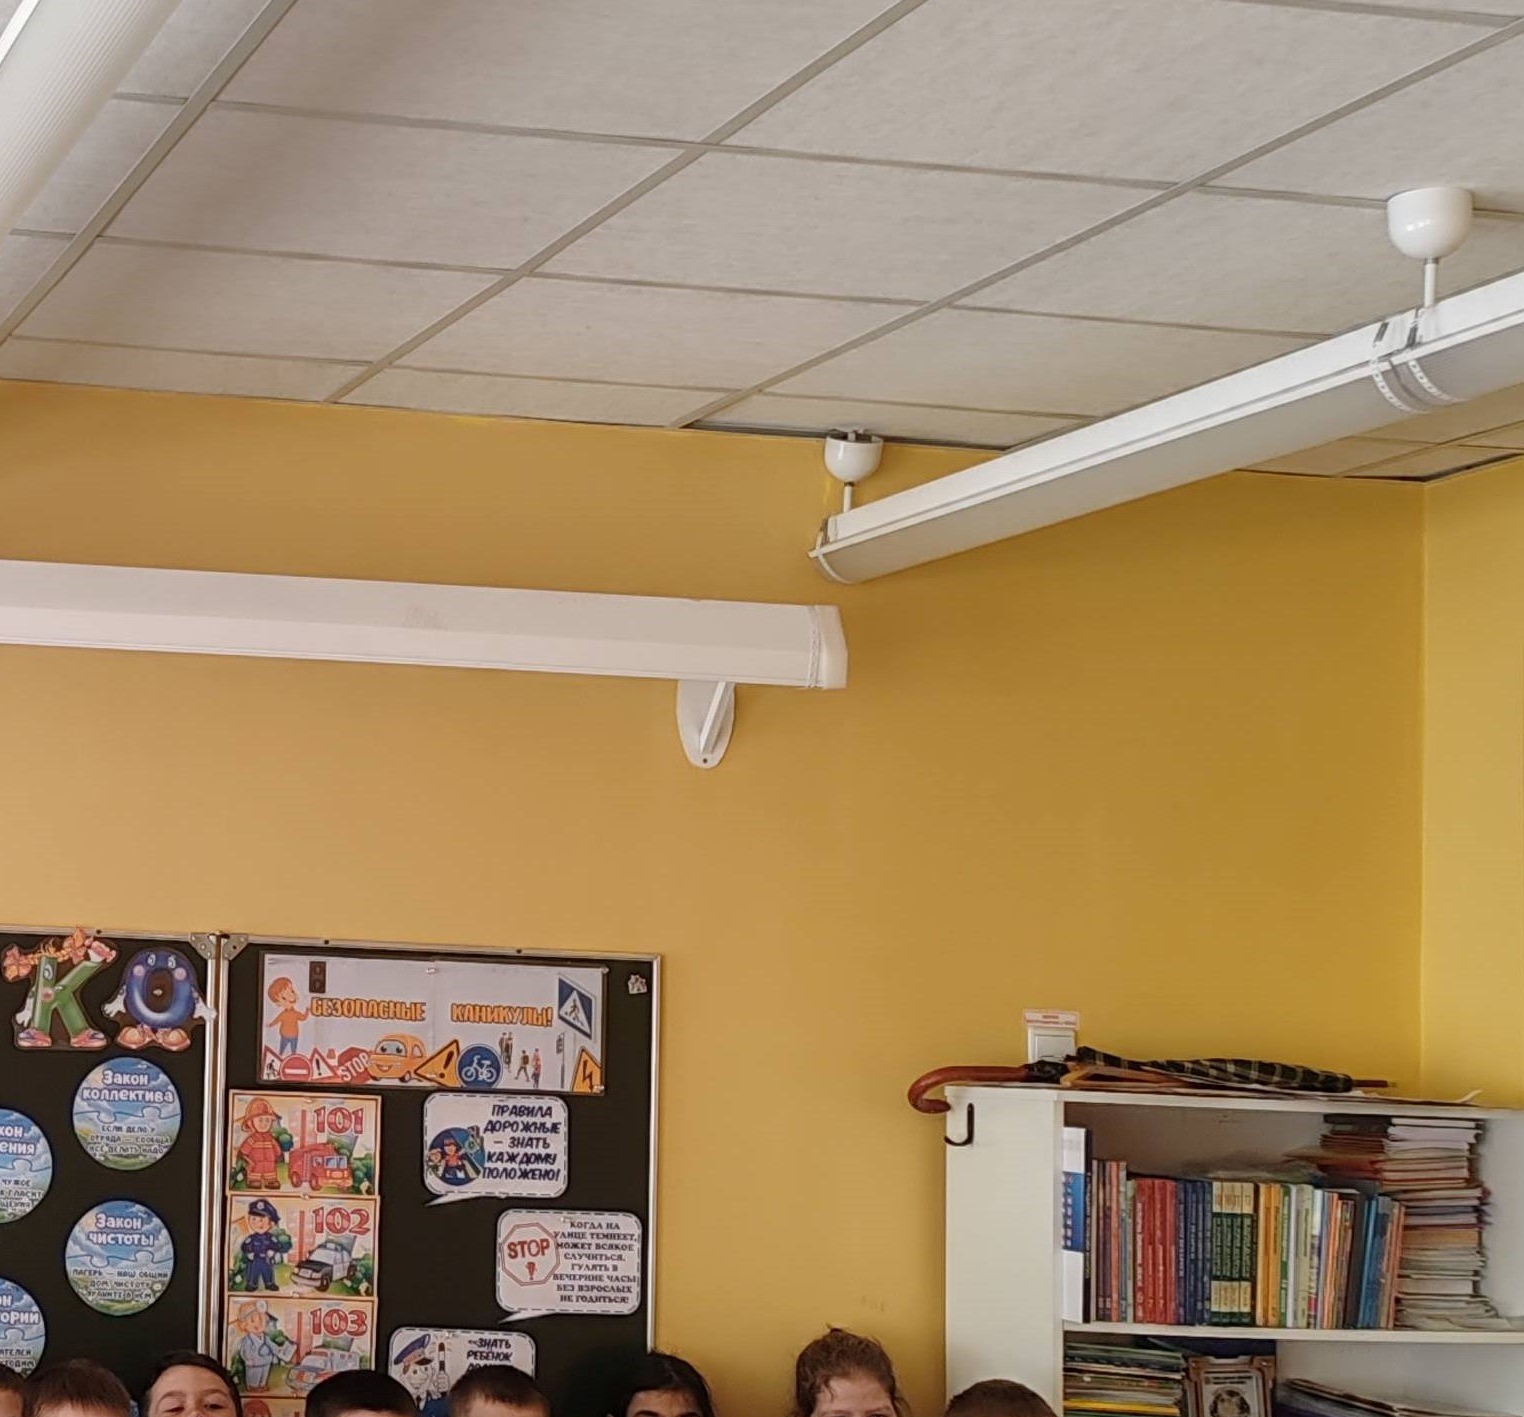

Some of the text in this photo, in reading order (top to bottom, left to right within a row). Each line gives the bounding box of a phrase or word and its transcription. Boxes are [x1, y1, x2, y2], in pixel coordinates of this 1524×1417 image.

[310, 996, 427, 1022] БЕЗОПАСНЫЕ
[450, 1002, 554, 1028] КАНИКУЛЫ!
[338, 1051, 371, 1083] STOP
[102, 1068, 151, 1087] Закон
[82, 1086, 176, 1105] коллектива
[491, 1104, 553, 1118] ПРАВИЛА
[313, 1106, 364, 1135] 101
[483, 1119, 562, 1135] ДОРОЖНЫЕ
[101, 1125, 124, 1134] ЕСЛИ
[126, 1126, 148, 1135] ДЕЛО
[508, 1136, 550, 1150] ЗНАТЬ
[486, 1151, 557, 1167] КАЖДОМУ
[481, 1166, 561, 1182] ПОЛОЖЕНО!
[95, 1212, 143, 1230] Закон
[310, 1207, 370, 1235] 102
[570, 1221, 620, 1230] КОГДА НА
[88, 1231, 154, 1247] чистоты
[554, 1231, 587, 1239] УЛИЦЕ
[507, 1238, 550, 1259] STOP
[556, 1242, 634, 1251] МОЖЕТ ВСЯКОЕ
[571, 1263, 609, 1272] ГУЛЯТЬ
[553, 1273, 603, 1282] ВЕЧЕРНИЕ
[557, 1284, 632, 1293] БЕЗ ВЗРОСЛЫХ
[560, 1294, 574, 1302] НЕ
[311, 1308, 367, 1336] 103
